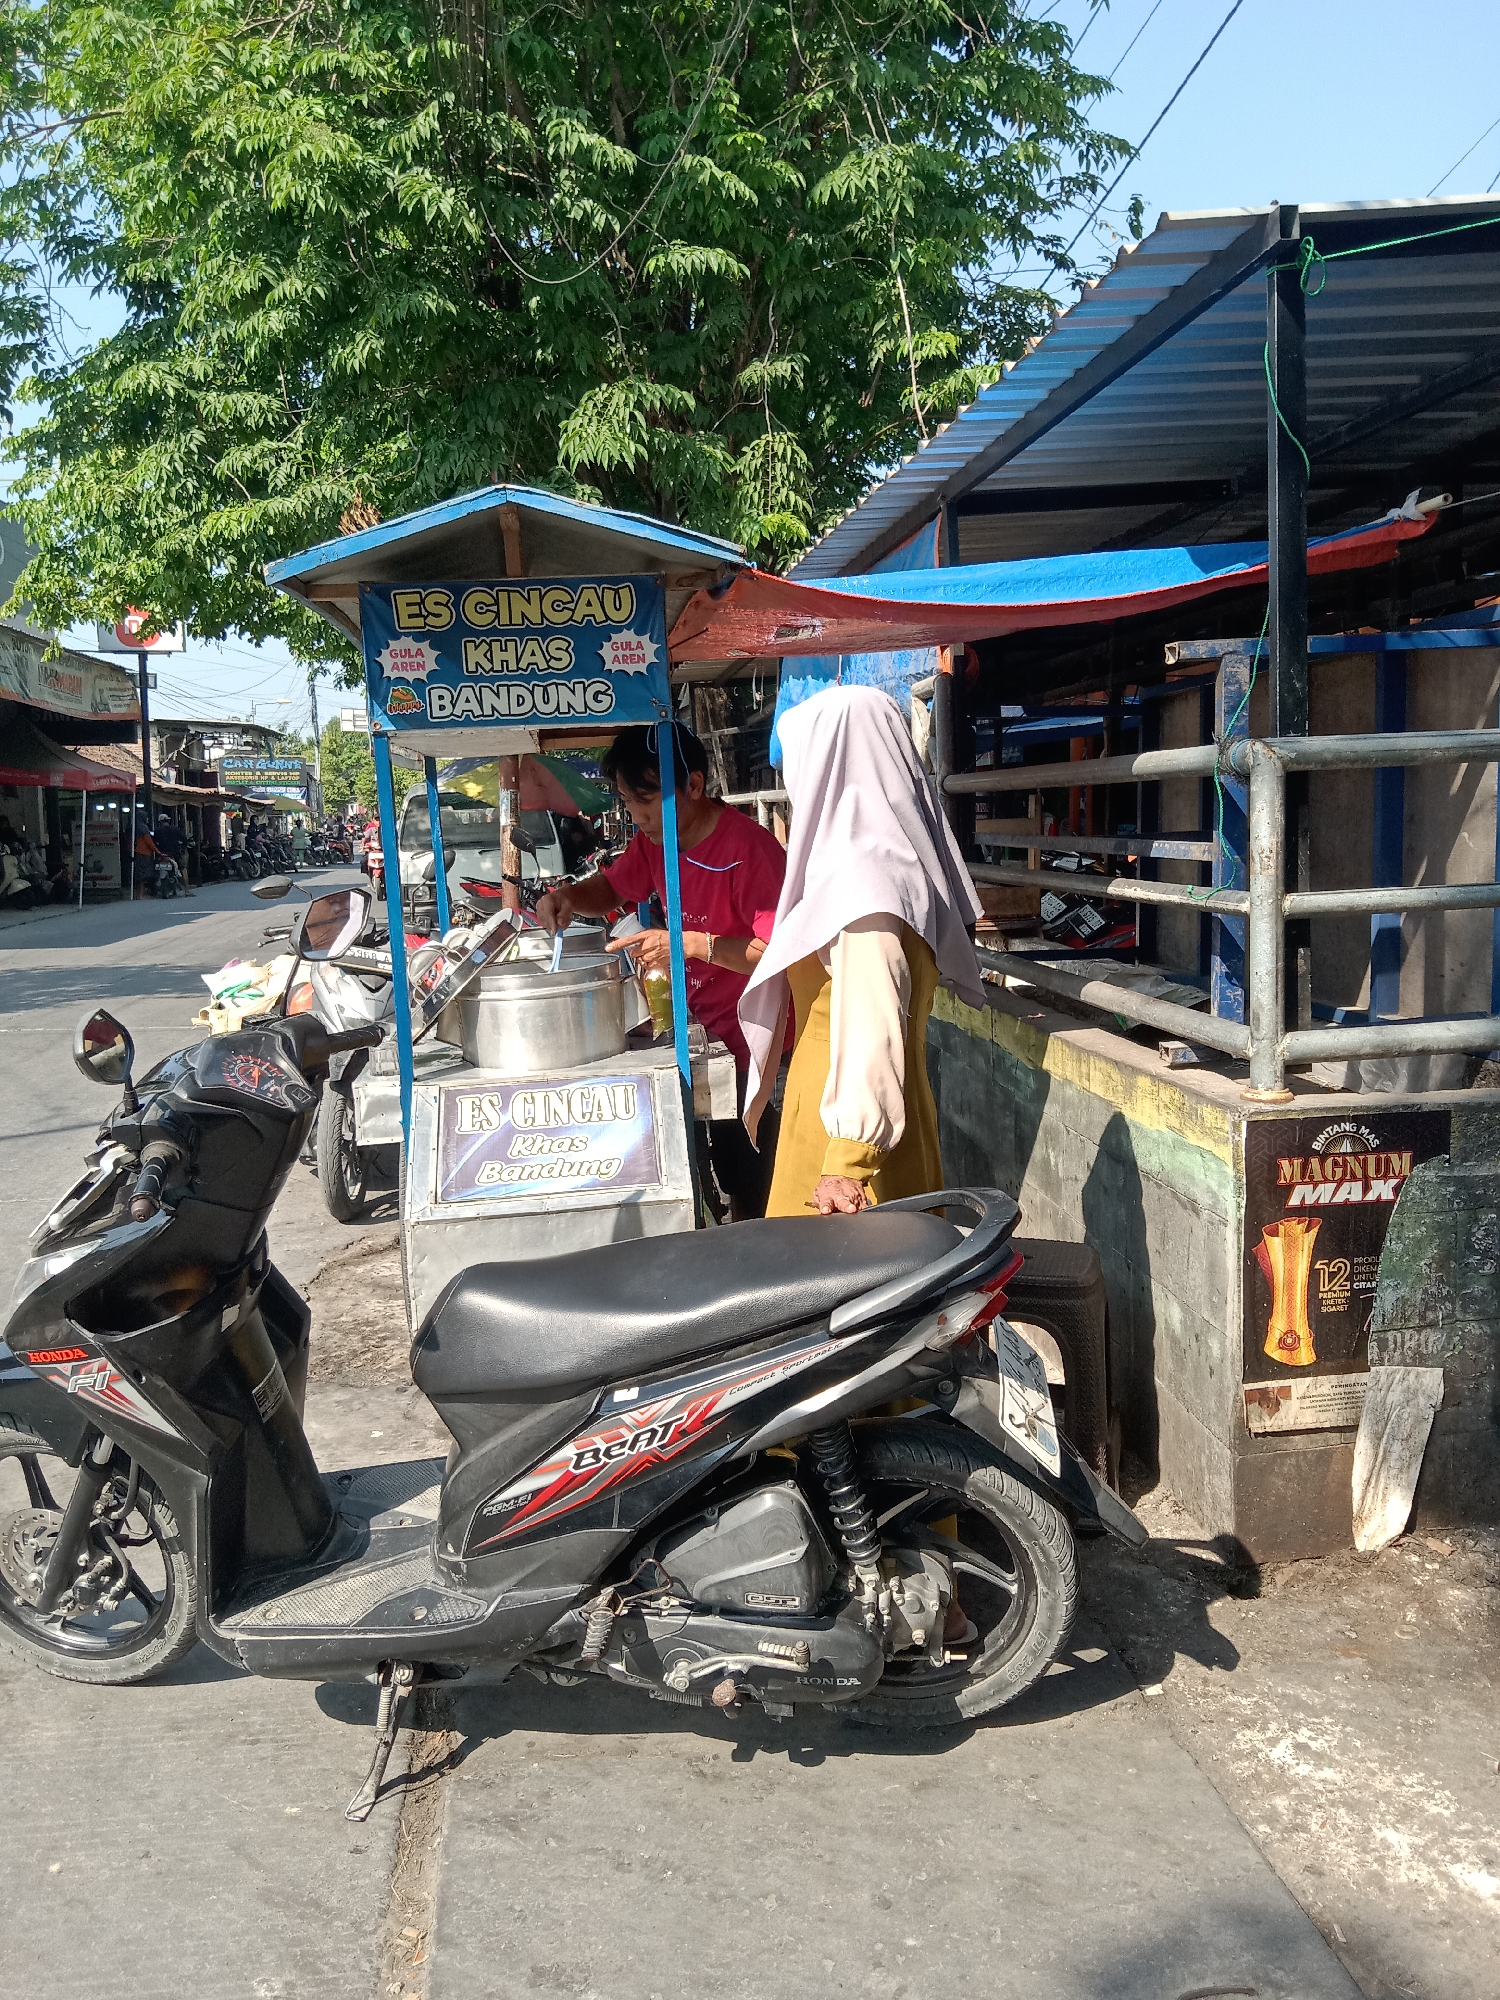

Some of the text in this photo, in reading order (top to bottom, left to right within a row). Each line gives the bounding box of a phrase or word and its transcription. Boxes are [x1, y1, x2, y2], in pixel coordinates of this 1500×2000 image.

[393, 584, 635, 630] ES CINCAU
[389, 647, 425, 660] GULA
[463, 637, 574, 675] KHAS
[610, 640, 645, 653] GULA
[390, 661, 427, 672] AREN
[611, 653, 646, 665] AREN
[429, 681, 614, 721] BANDUNG
[457, 1084, 637, 1133] ES CINCAU
[510, 1134, 588, 1157] Khas
[1312, 1122, 1380, 1151] BINTANG MAS
[476, 1158, 622, 1185] Bandung
[1278, 1152, 1413, 1184] MAGNUM
[1286, 1179, 1401, 1208] MAX
[1314, 1257, 1351, 1292] 12
[1319, 1291, 1350, 1299] PREMIUM
[1321, 1305, 1349, 1313] SIGARET
[28, 1347, 88, 1363] HONDA
[67, 1370, 111, 1393] FI
[729, 1372, 776, 1395] Compact
[794, 1676, 861, 1687] HONDA
